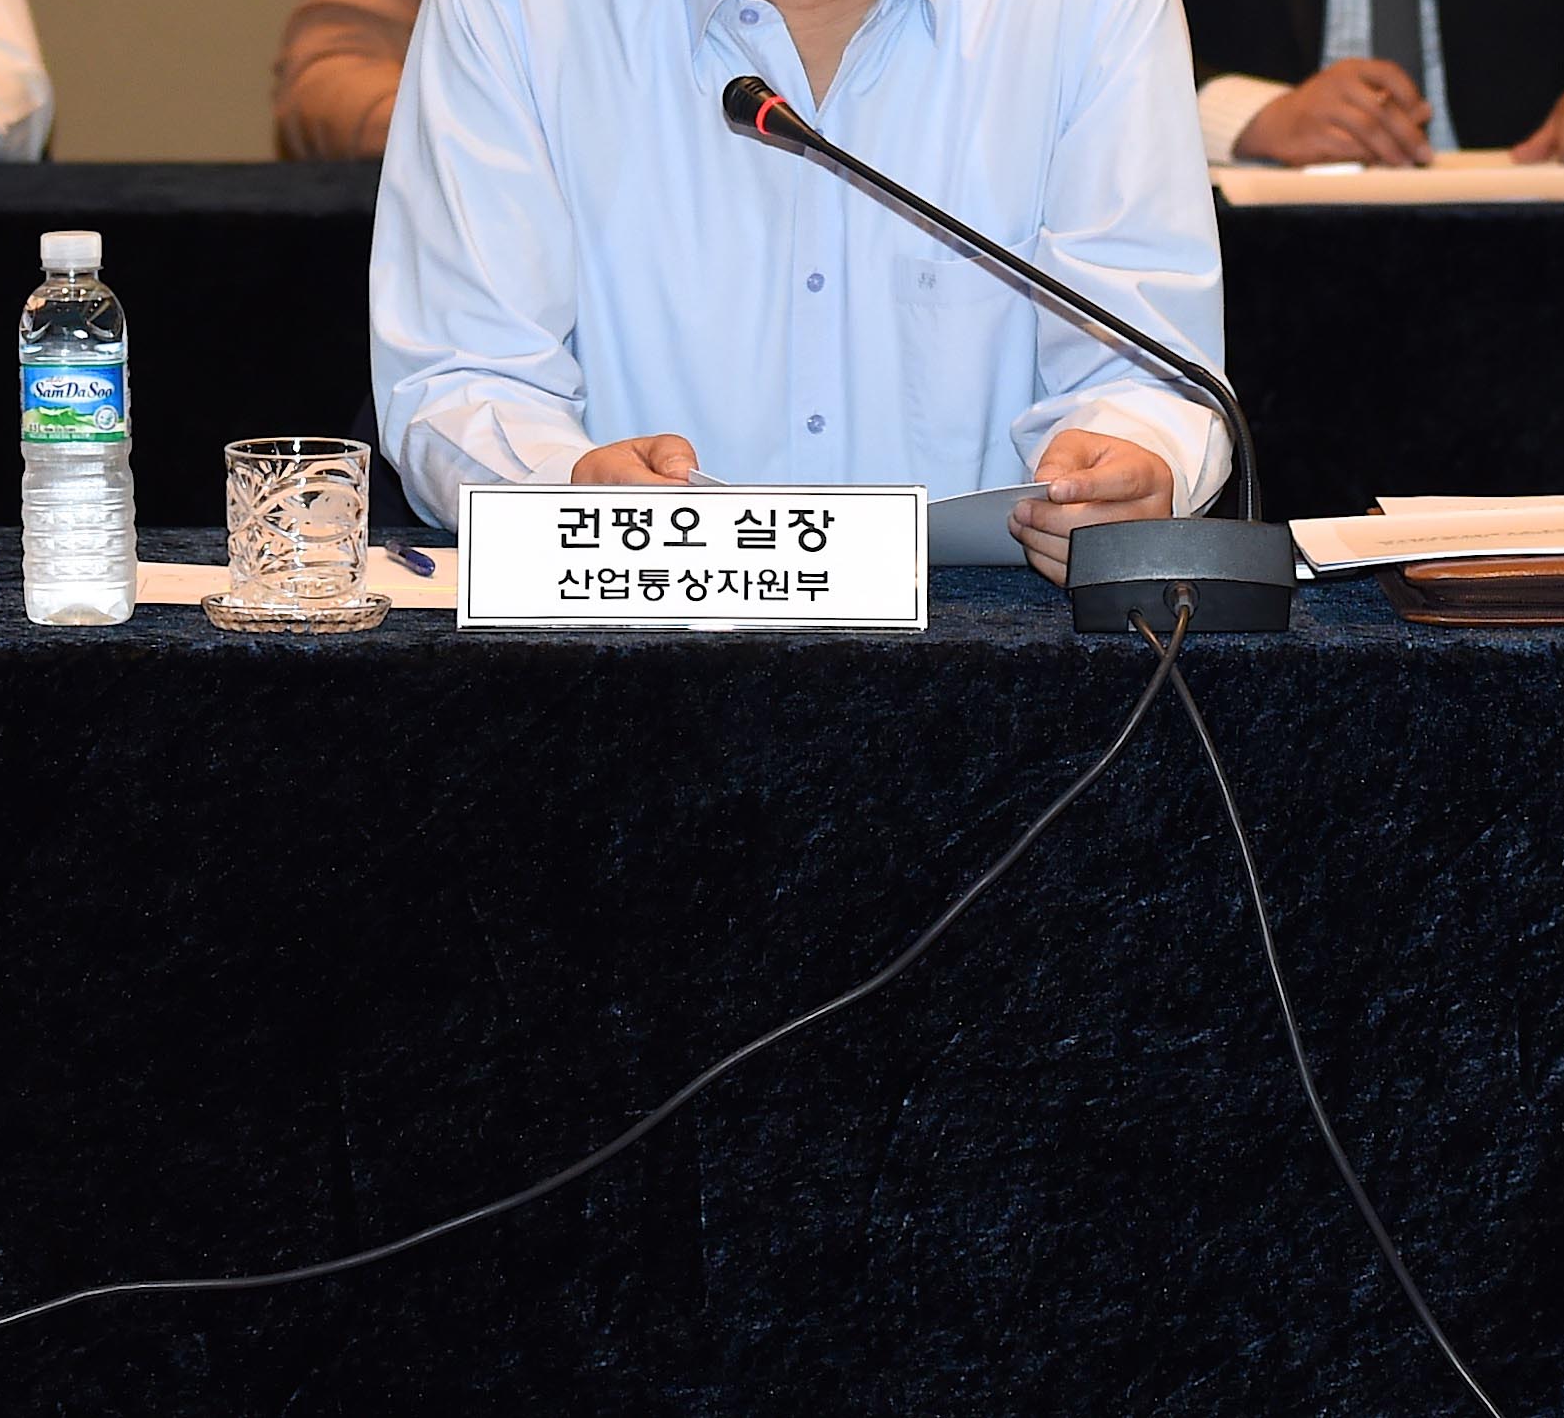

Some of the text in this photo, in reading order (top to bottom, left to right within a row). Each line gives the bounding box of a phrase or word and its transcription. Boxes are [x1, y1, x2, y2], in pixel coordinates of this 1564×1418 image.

[557, 506, 835, 553] 권평오 실장
[557, 568, 830, 602] 산업통상자원부
